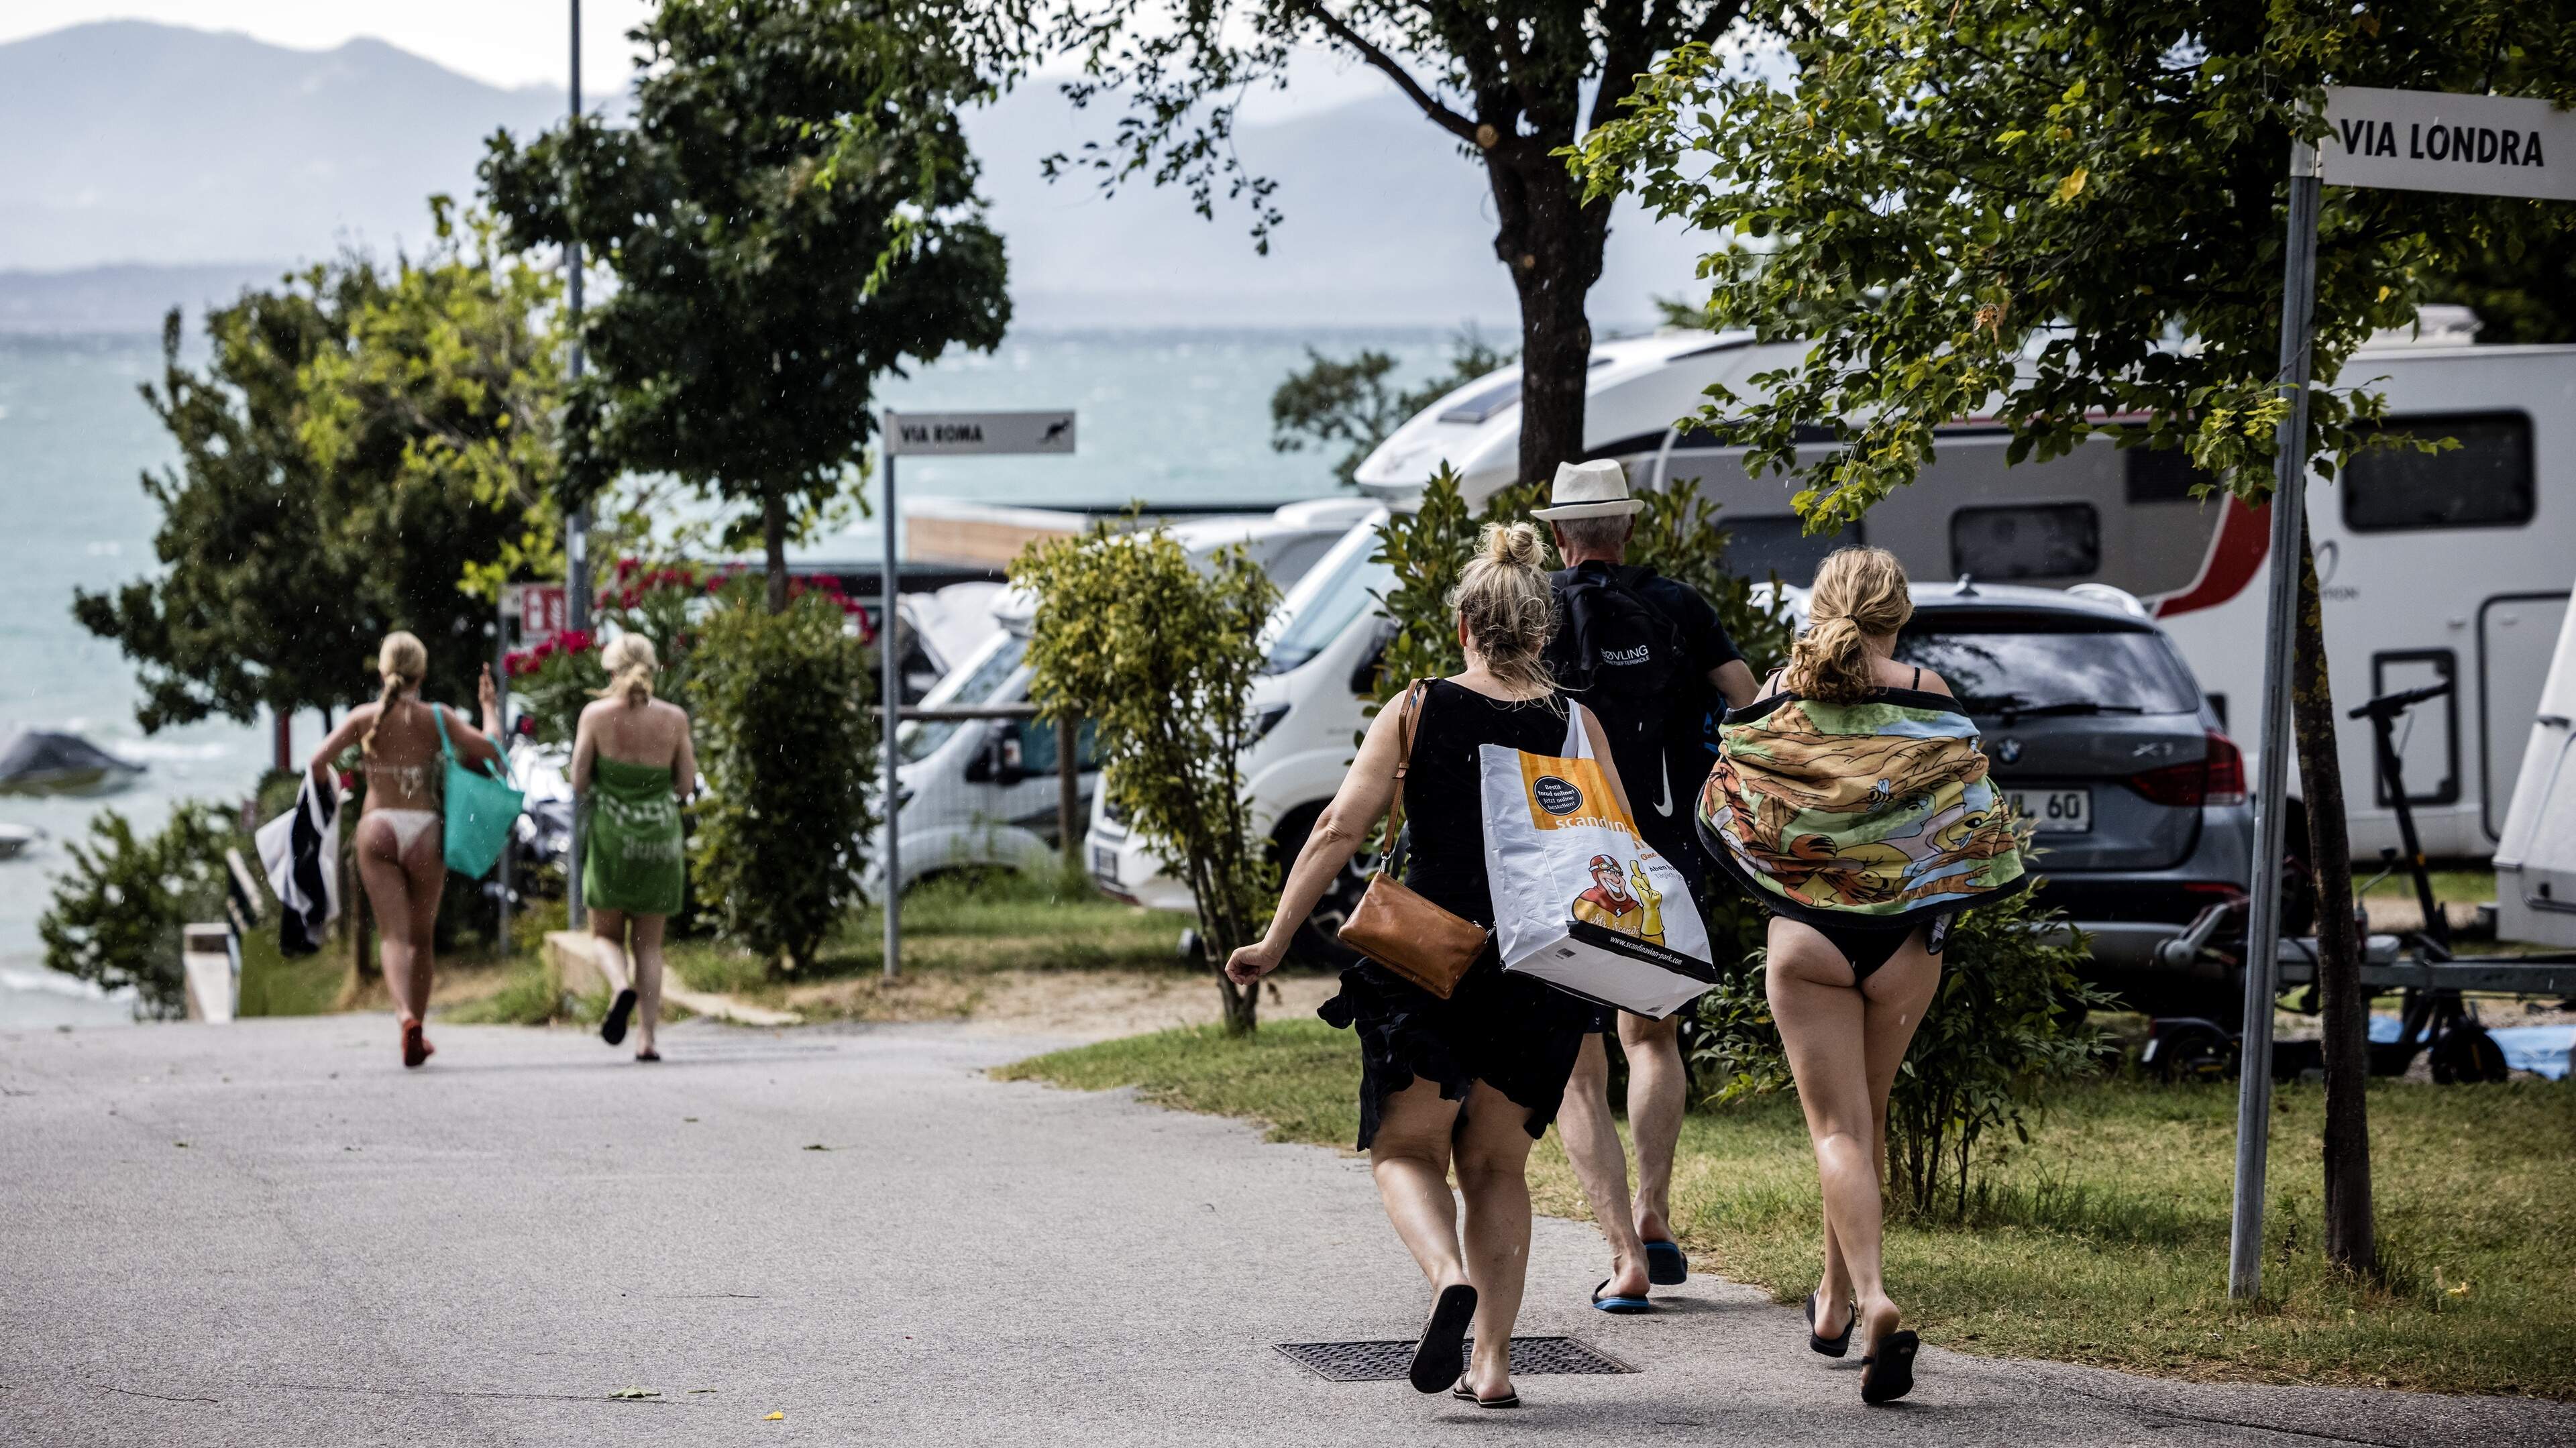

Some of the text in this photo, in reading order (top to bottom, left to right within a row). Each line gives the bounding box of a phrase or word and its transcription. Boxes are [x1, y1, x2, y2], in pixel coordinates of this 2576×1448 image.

[2341, 119, 2544, 167] VIA LONDRA
[901, 424, 983, 443] VIA ROMA
[2133, 743, 2174, 757] X1
[1548, 801, 1576, 810] bestellen!
[2047, 793, 2080, 819] 60
[1556, 816, 1630, 833] scandin
[1589, 913, 1640, 936] Mr. Scandi
[1610, 936, 1682, 965] www.scandinavian-park.com
